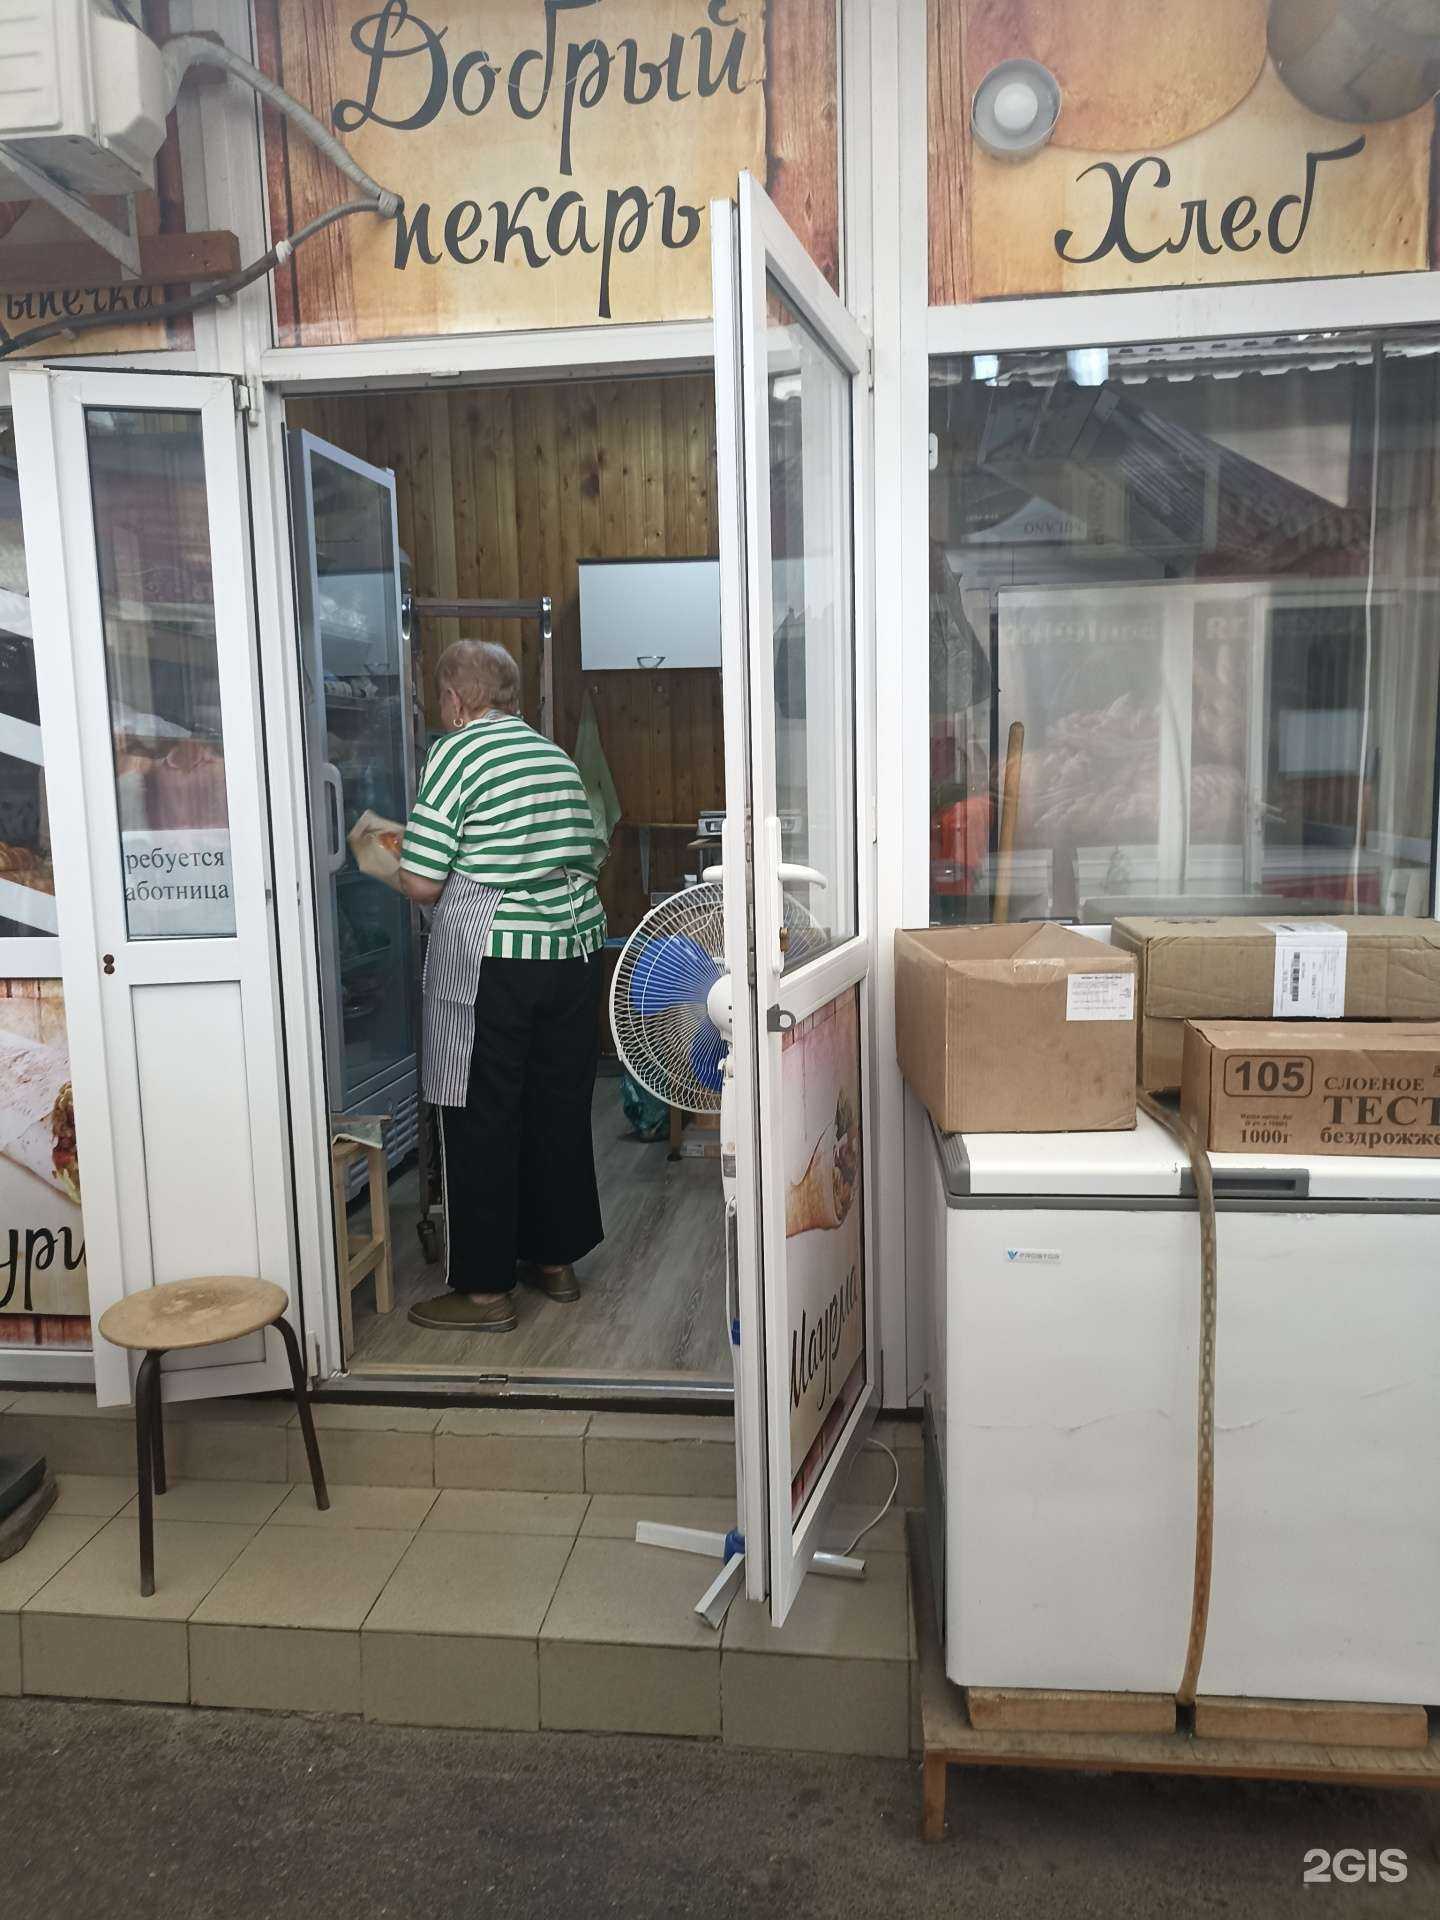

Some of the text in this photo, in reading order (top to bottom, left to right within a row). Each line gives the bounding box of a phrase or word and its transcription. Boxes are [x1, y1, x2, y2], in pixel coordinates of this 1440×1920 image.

[331, 0, 747, 176] Добрый
[1054, 135, 1366, 264] Хлеб
[394, 185, 706, 319] пекарь
[1235, 1060, 1305, 1092] 105
[1323, 1076, 1425, 1092] СЛОЕНОЕ
[1240, 1129, 1293, 1144] 1000г
